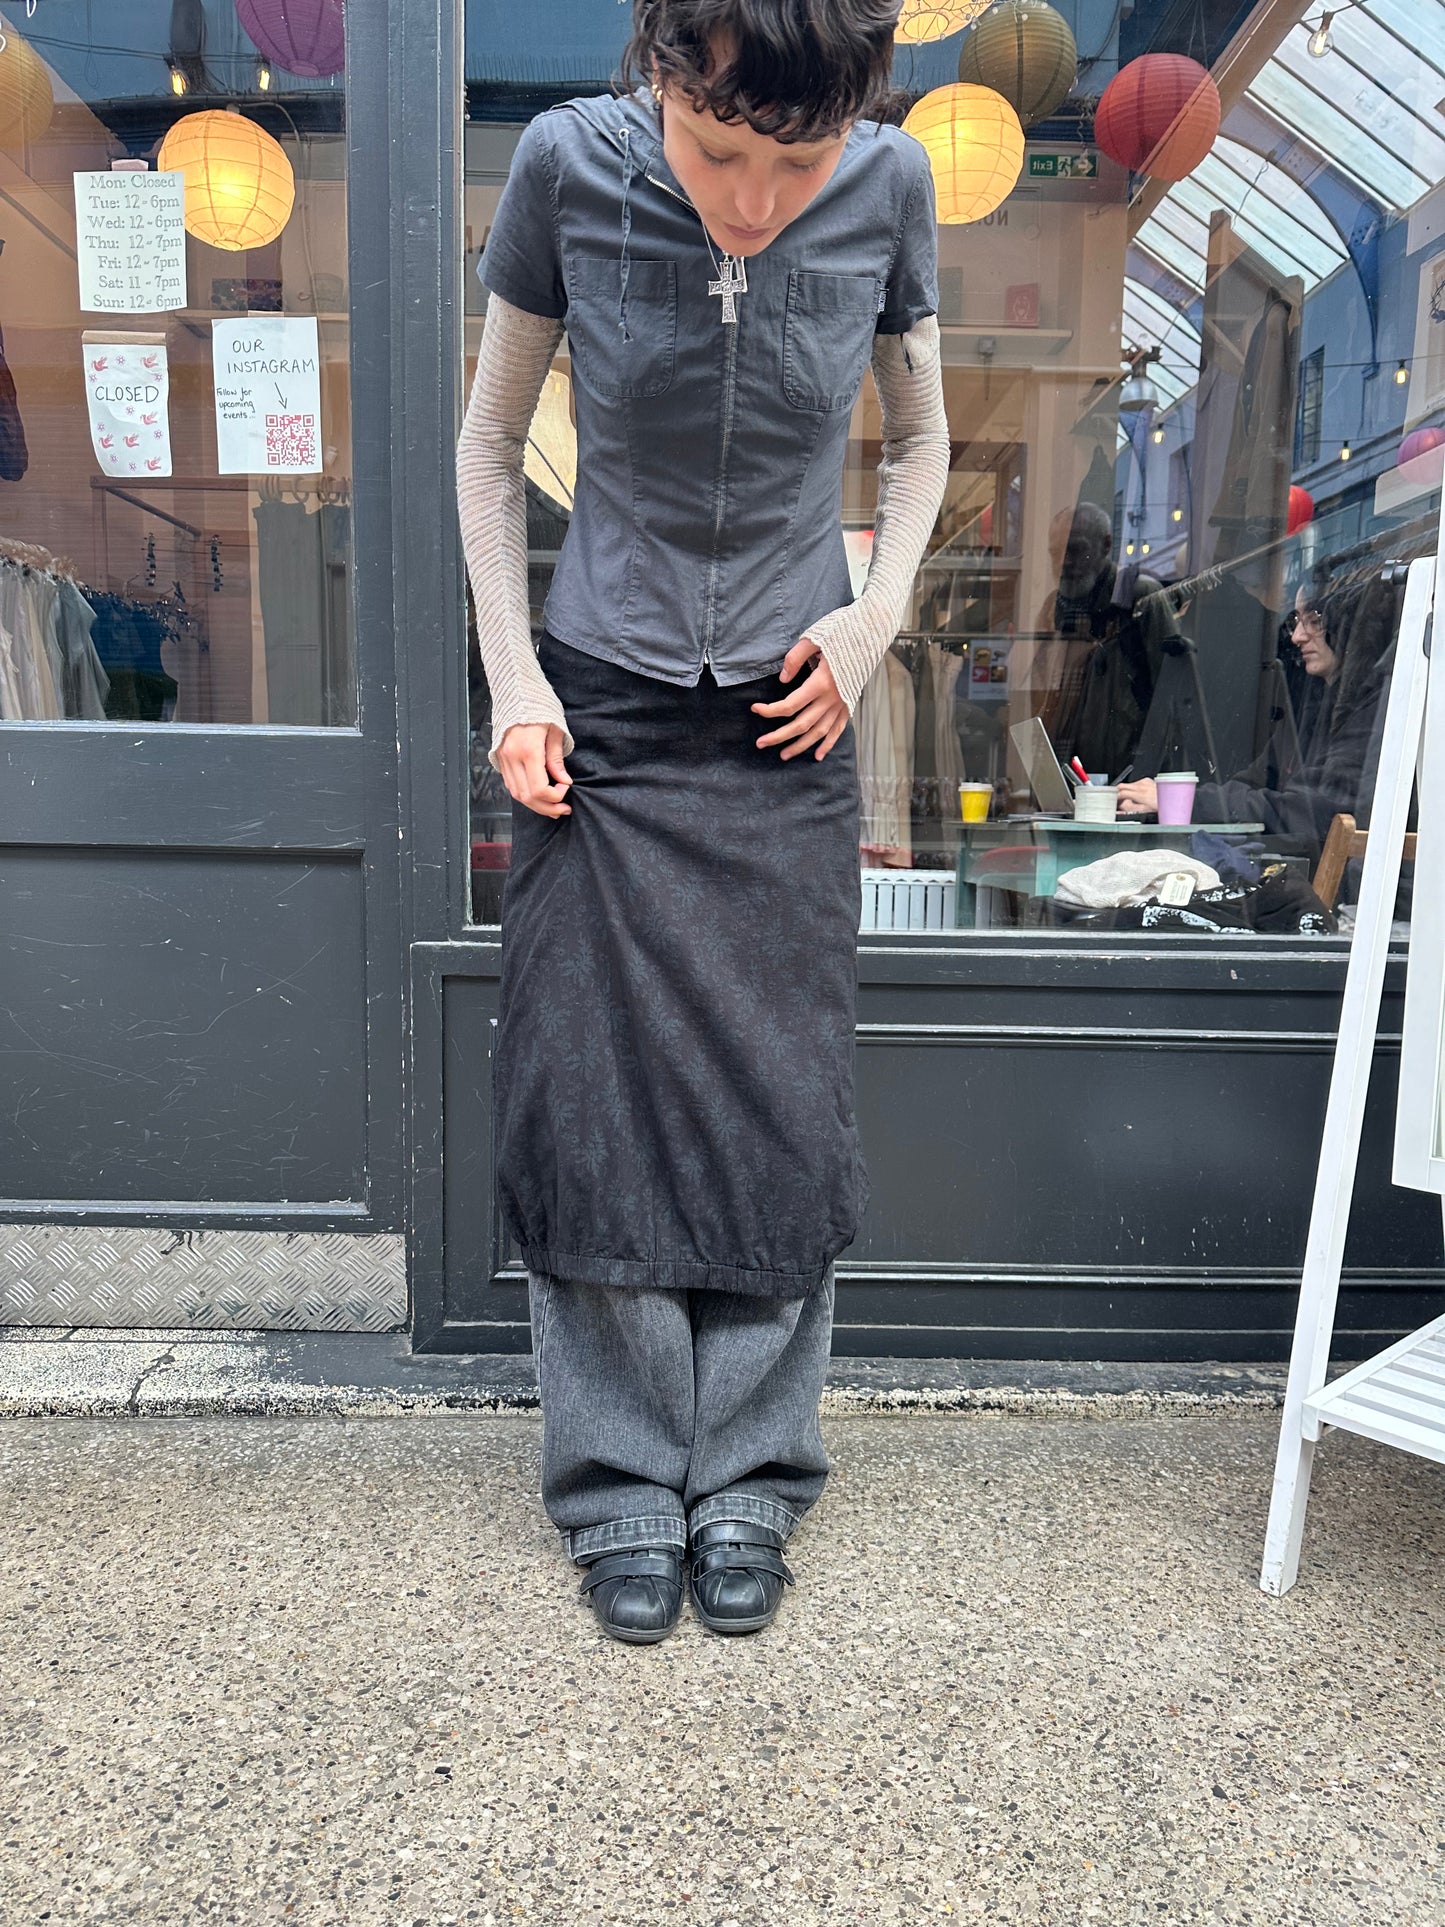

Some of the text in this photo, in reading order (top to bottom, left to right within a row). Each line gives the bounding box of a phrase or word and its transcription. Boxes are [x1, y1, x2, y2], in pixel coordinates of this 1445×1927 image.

[90, 174, 176, 189] Mon: Closed
[89, 196, 120, 208] Tue:
[87, 215, 125, 228] Wed:
[85, 235, 119, 249] Thu:
[98, 255, 122, 269] Fri:
[99, 275, 124, 288] Sat:
[93, 294, 124, 308] Sun:
[232, 339, 264, 353] OUR
[228, 358, 315, 374] INSTAGRAM
[95, 386, 159, 403] CLOSED
[216, 387, 252, 401] Follow for
[219, 400, 255, 413] upcoming
